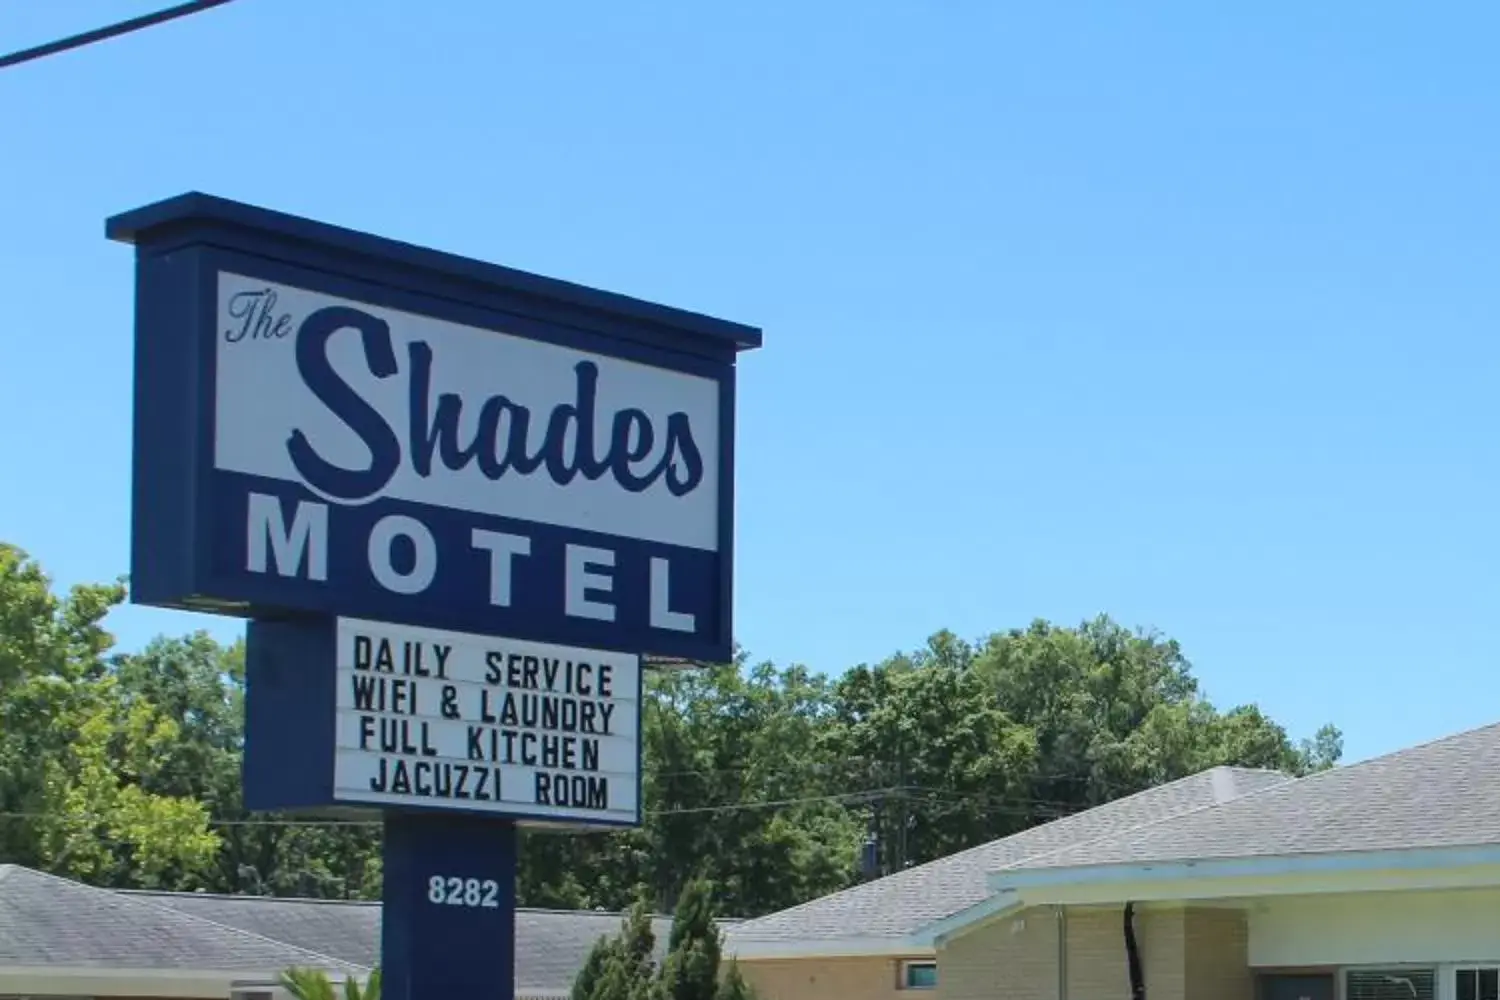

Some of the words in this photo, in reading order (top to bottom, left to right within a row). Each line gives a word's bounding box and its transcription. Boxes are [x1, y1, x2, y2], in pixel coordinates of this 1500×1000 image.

[225, 287, 294, 343] The
[286, 305, 703, 499] Shades
[246, 492, 697, 634] MOTEL
[353, 634, 451, 680] DAILY
[485, 650, 613, 698] SERVICE
[439, 684, 461, 720] &
[481, 689, 614, 736] LAUNDRY
[360, 717, 437, 756] FULL
[467, 726, 600, 772] KITCHEN
[370, 759, 501, 801] JACUZZI
[536, 772, 608, 809] ROOM
[428, 875, 499, 907] 8282
